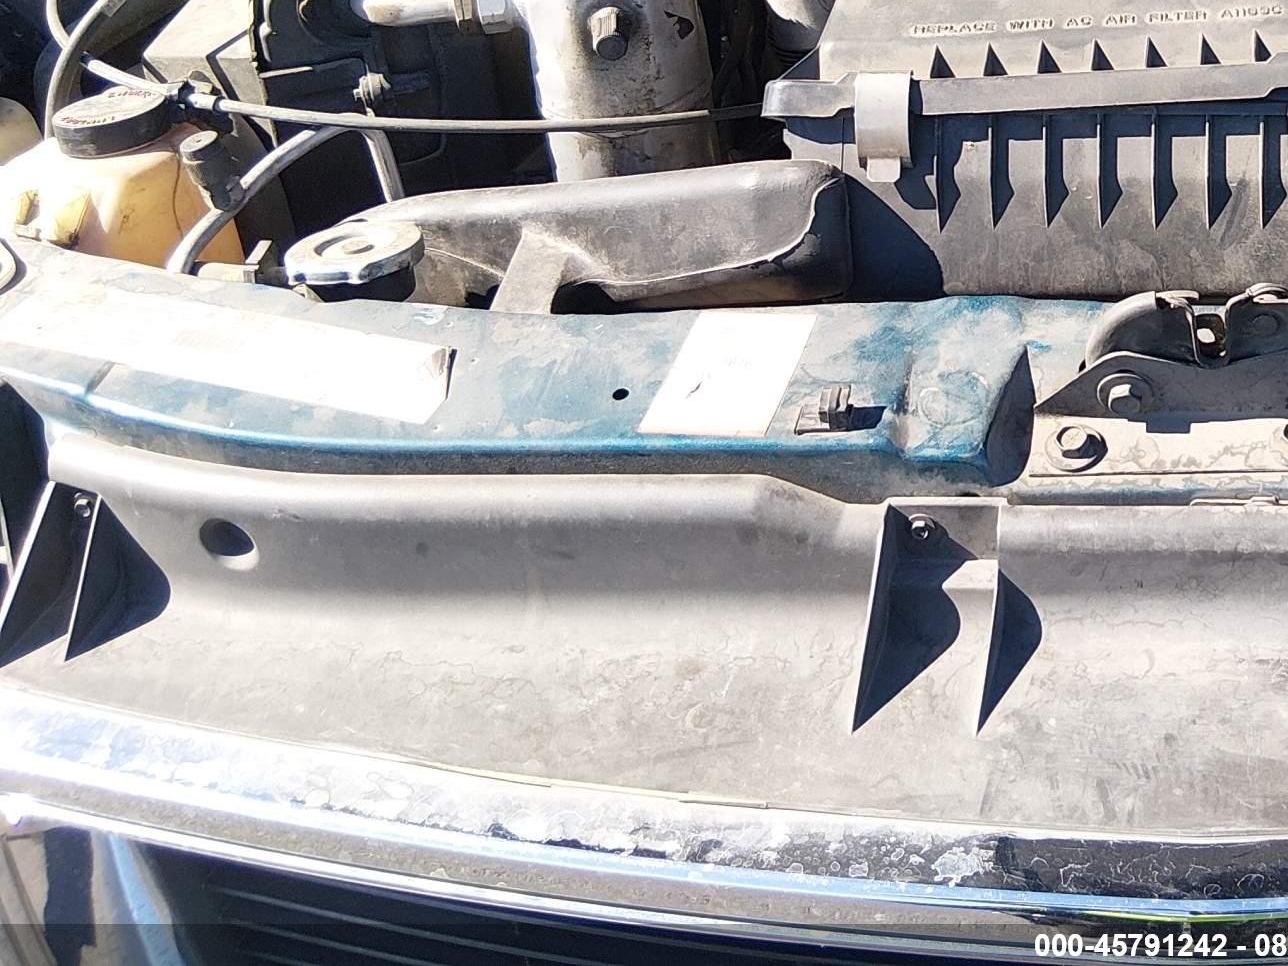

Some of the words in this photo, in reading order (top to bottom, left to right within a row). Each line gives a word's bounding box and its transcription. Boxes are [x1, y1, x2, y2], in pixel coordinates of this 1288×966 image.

[912, 21, 998, 36] REPLACE
[1008, 17, 1055, 31] WITH
[1065, 15, 1093, 28] AC
[1105, 14, 1137, 26] AIR
[1148, 10, 1208, 23] FILTER
